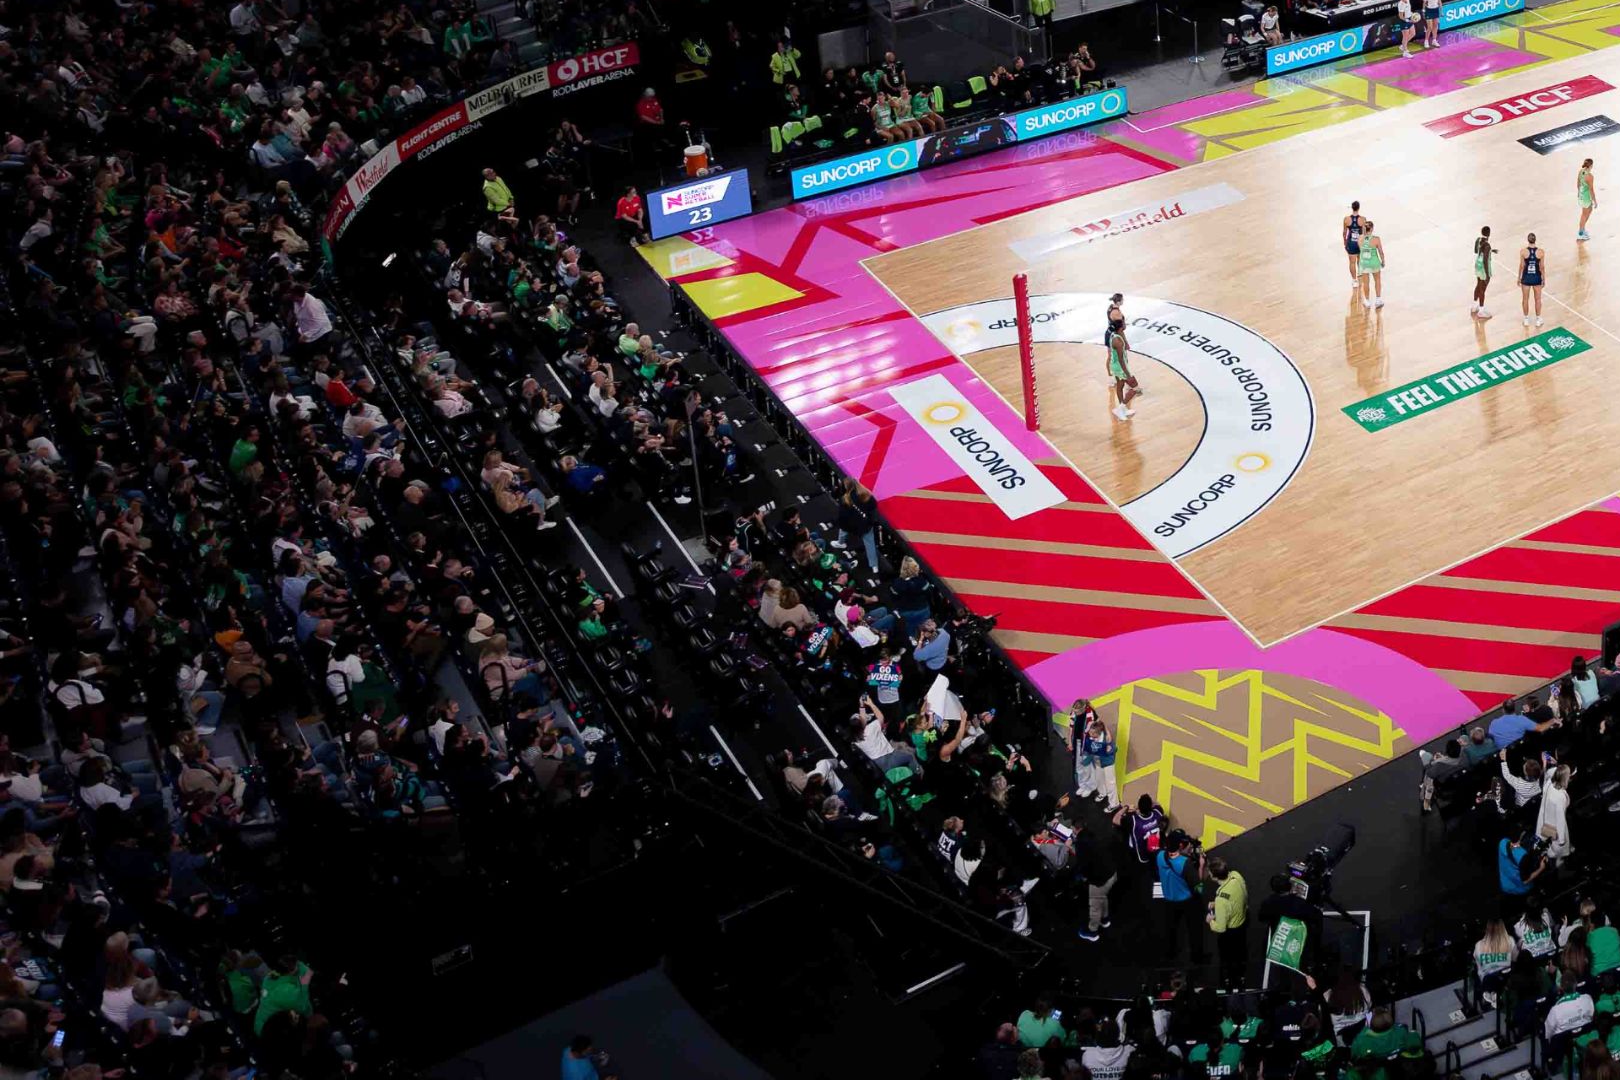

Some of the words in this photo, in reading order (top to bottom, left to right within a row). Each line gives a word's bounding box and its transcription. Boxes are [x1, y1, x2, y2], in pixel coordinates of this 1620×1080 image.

[582, 48, 629, 73] HCF
[1274, 41, 1335, 66] SUNCORP
[468, 71, 545, 112] MELBOURNE
[1503, 84, 1573, 116] HCF
[401, 131, 429, 152] FLIGHT
[428, 112, 462, 134] CENTRE
[1025, 102, 1096, 131] SUNCORP
[355, 155, 388, 194] Westfield
[802, 157, 882, 189] SUNCORP
[689, 208, 712, 224] 23
[1132, 317, 1181, 336] SHO
[1179, 331, 1240, 366] SUPER
[1387, 388, 1445, 415] FEEL
[1435, 366, 1488, 396] THE
[1480, 343, 1552, 380] FEVER
[1231, 366, 1272, 431] SUNCORP
[950, 426, 1025, 490] SUNCORP
[1154, 474, 1236, 537] SUNCORP
[807, 627, 829, 652] VIXENS
[809, 632, 818, 643] GO
[871, 672, 899, 681] VIXENS
[1272, 921, 1291, 951] FEVER
[1480, 952, 1508, 965] FEVER
